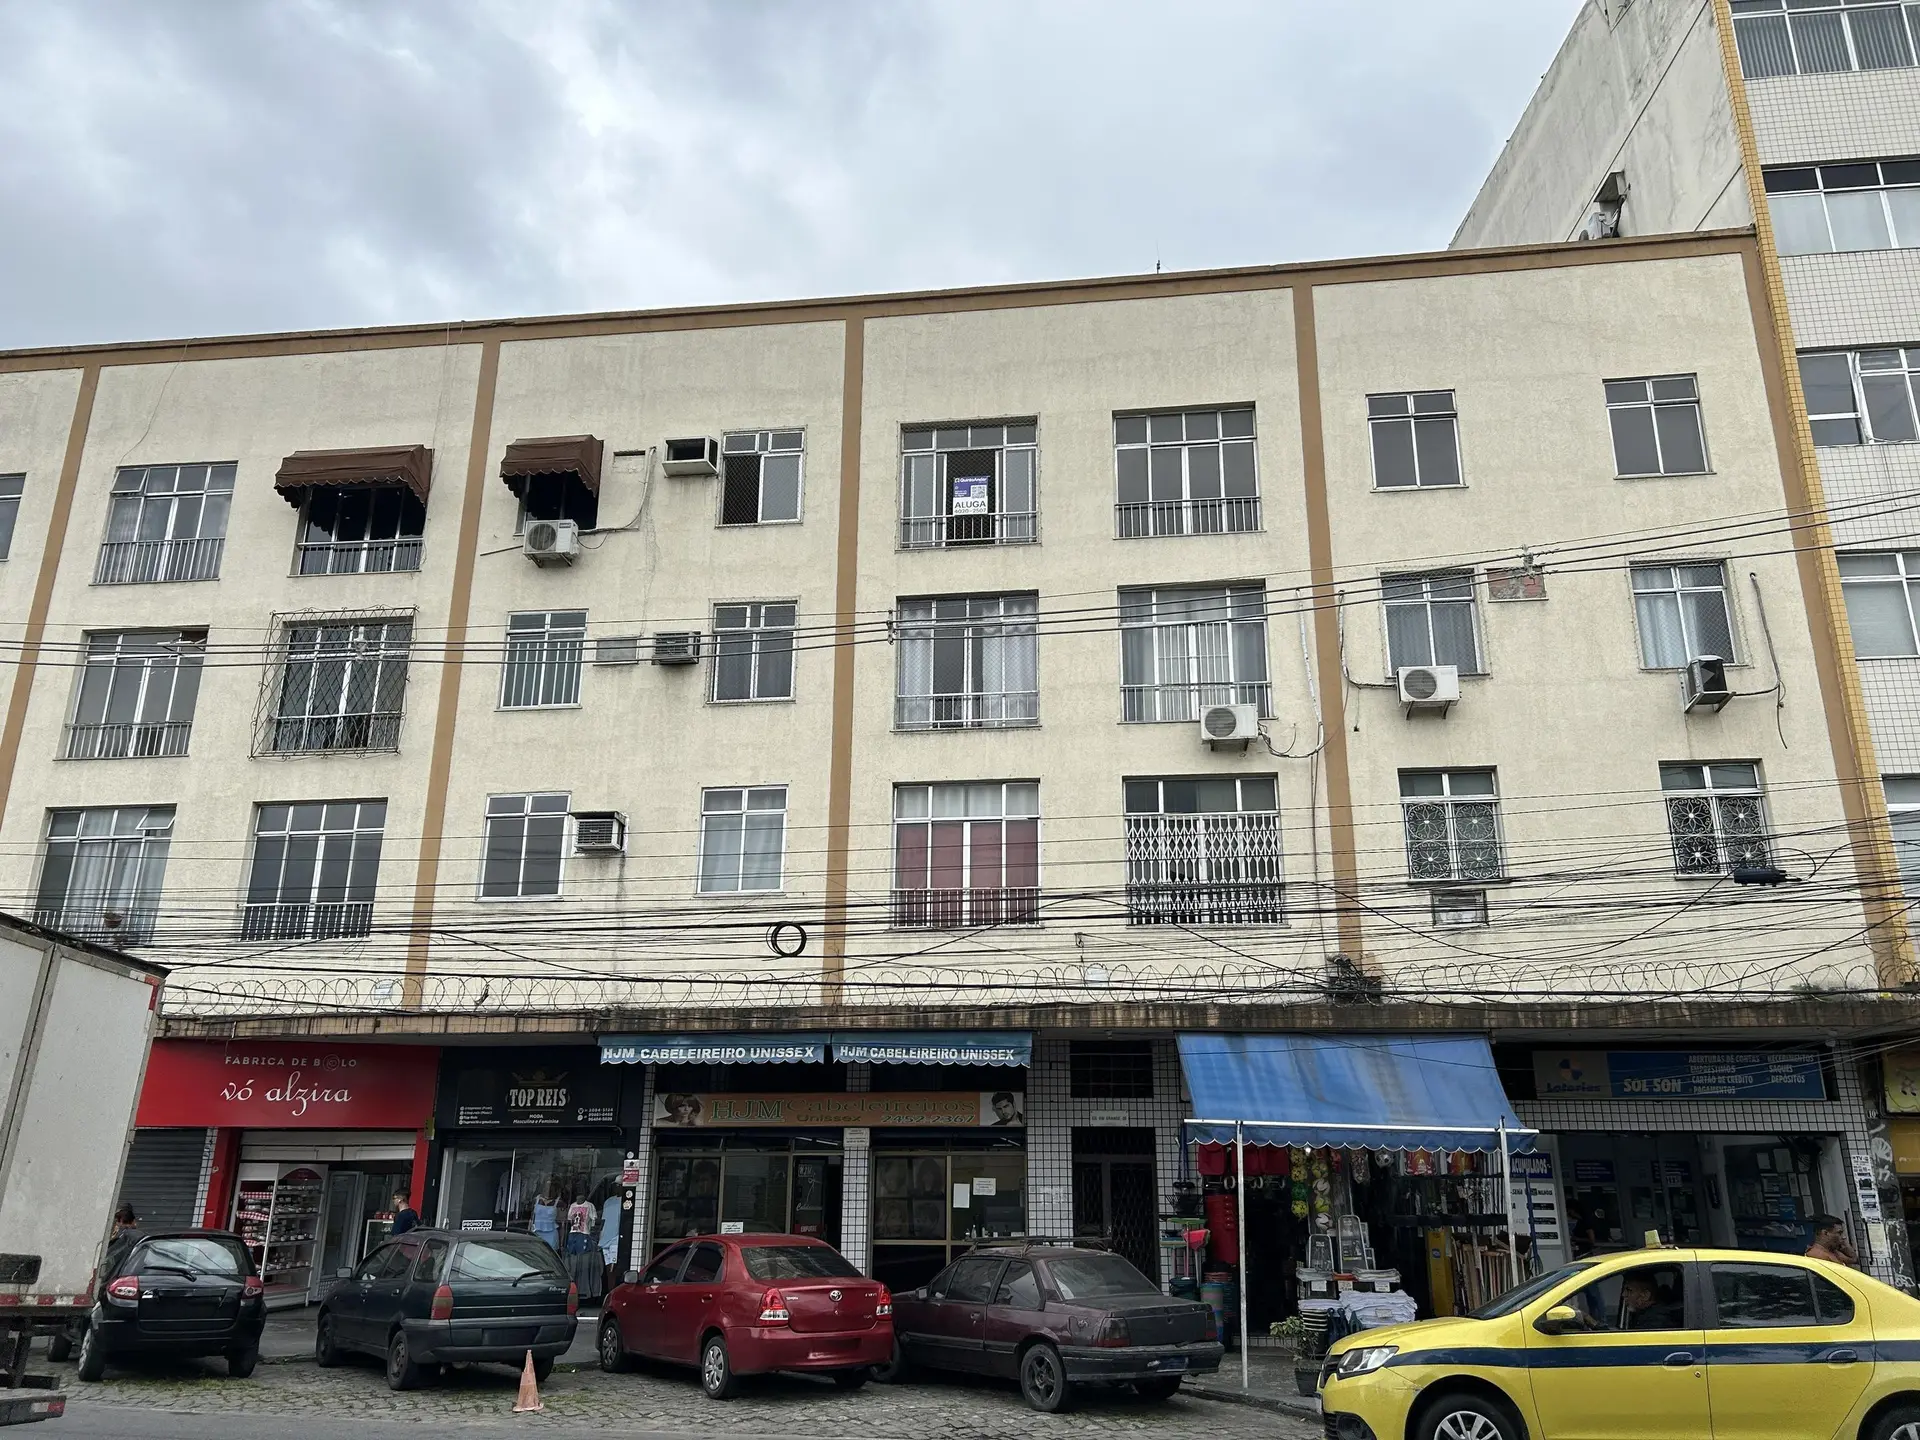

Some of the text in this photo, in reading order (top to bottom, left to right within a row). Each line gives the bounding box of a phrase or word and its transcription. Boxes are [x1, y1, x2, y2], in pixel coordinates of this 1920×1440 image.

[603, 1047, 814, 1059] HJM CABELEIREIRO UNISSEX
[840, 1046, 1014, 1060] HJM CABELEIREIRO UNISSEX
[291, 1058, 307, 1067] DE
[1546, 1082, 1601, 1093] Loterias
[1623, 1078, 1682, 1093] SOL SON
[220, 1071, 352, 1117] vó alzira
[509, 1088, 566, 1107] TOP REIS
[711, 1100, 784, 1119] HJM
[796, 1114, 861, 1122] Unissex
